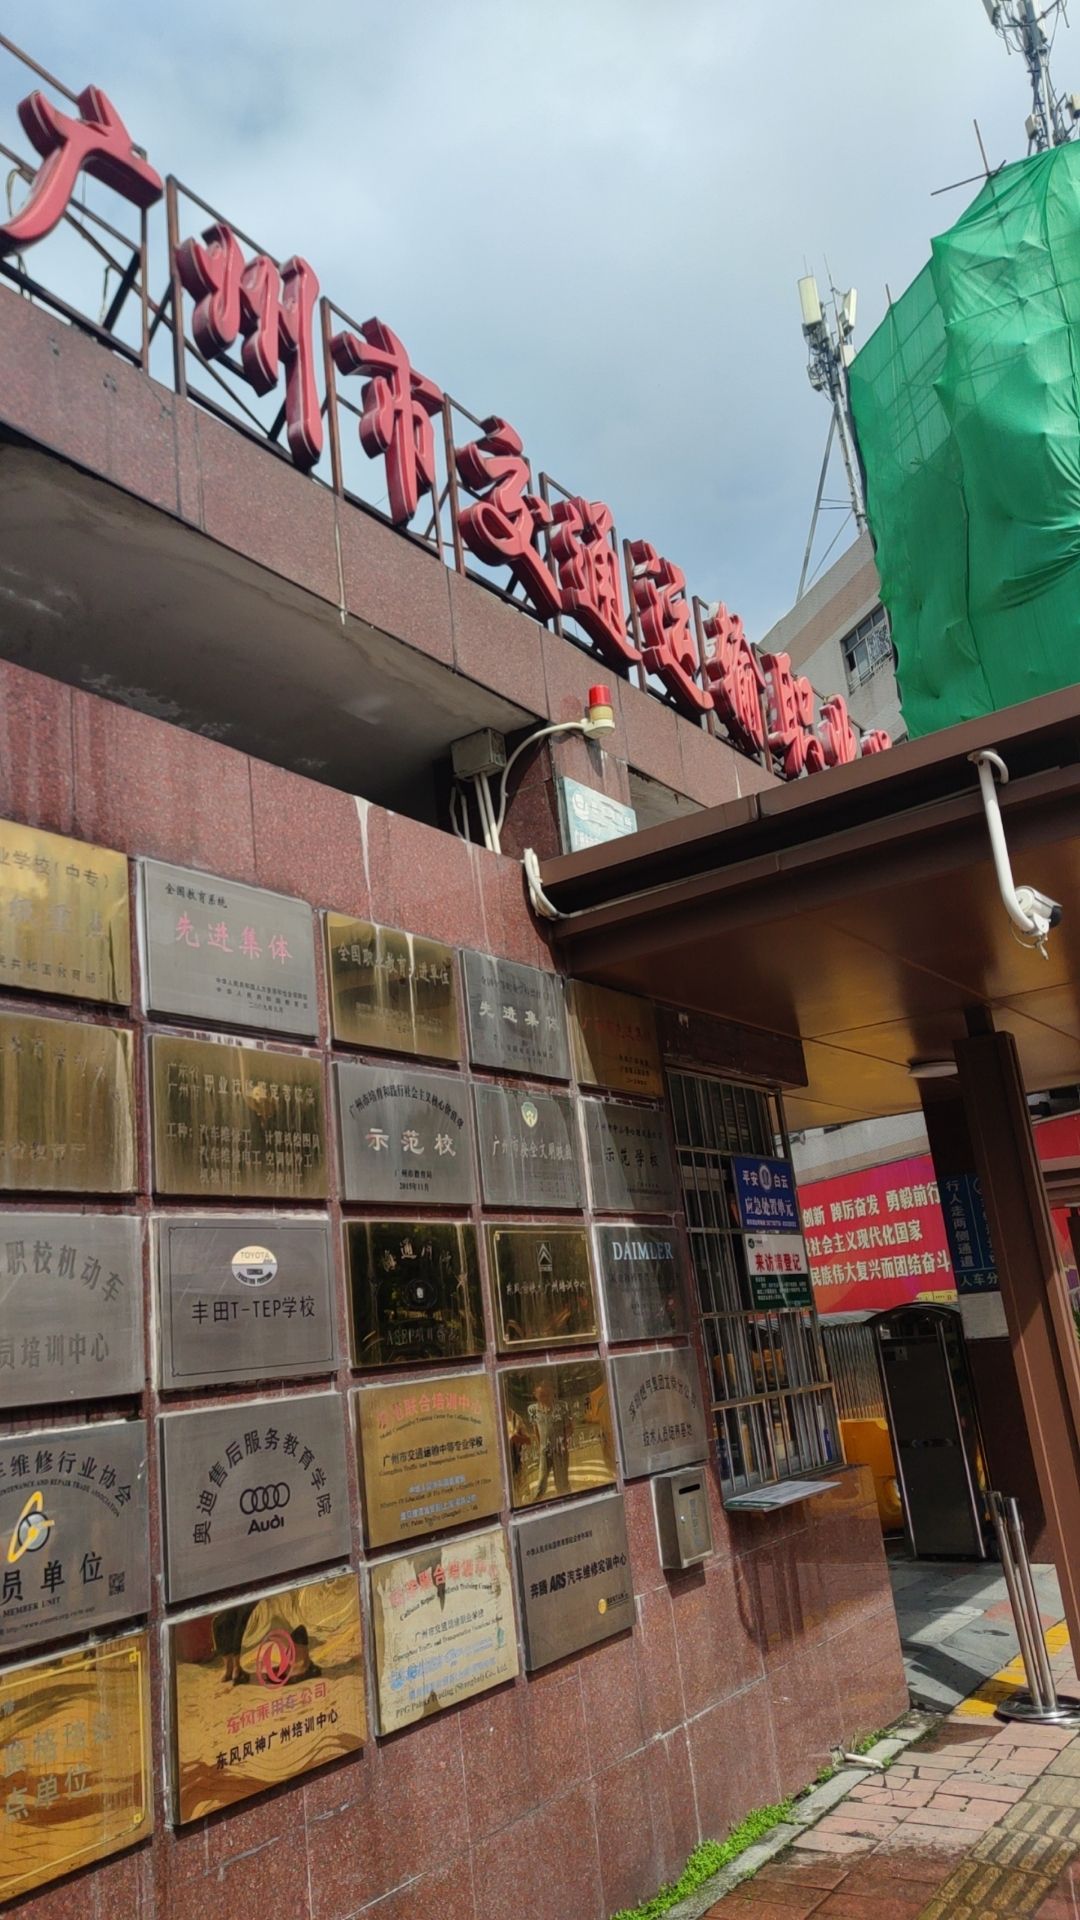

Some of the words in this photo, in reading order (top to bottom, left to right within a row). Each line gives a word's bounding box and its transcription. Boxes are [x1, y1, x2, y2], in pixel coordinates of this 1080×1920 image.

[165, 882, 228, 909] 全国教育系统
[175, 911, 293, 965] 先进集体
[365, 1127, 457, 1157] 示范校
[742, 1170, 759, 1187] 平安
[773, 1174, 789, 1189] 白云
[802, 1204, 826, 1228] 创新
[829, 1193, 881, 1223] 踔厉奋发
[885, 1180, 941, 1213] 勇毅前行
[240, 1251, 271, 1259] TOYOTA
[612, 1241, 674, 1260] DAIMLER
[754, 1253, 803, 1273] 来访请登记
[810, 1249, 951, 1287] 民族伟大复兴而团结奋斗
[192, 1295, 316, 1325] 丰田T-TEP学校
[193, 1427, 332, 1545] 奥迪售后服务教育学院
[248, 1514, 284, 1535] Audi
[1, 1551, 104, 1606] 员单位
[216, 1709, 338, 1769] 东风风神广州培训中心
